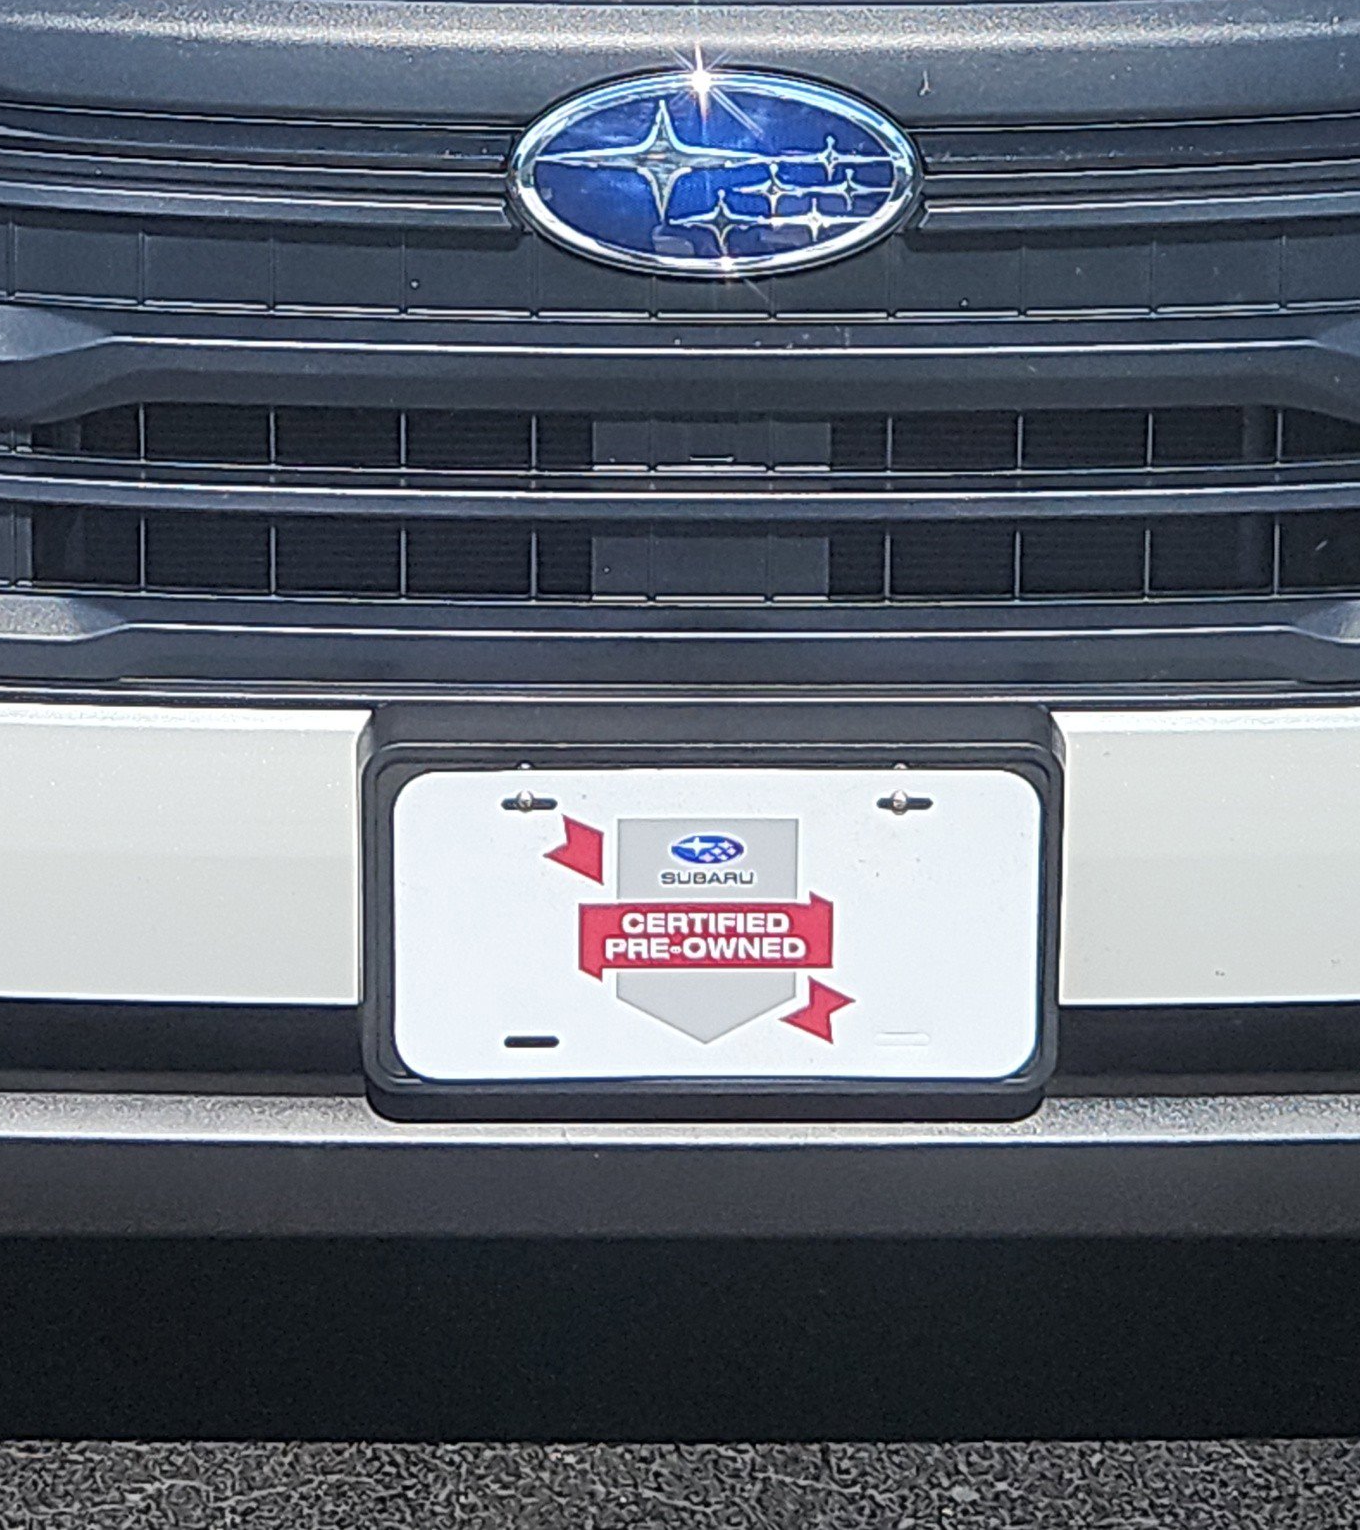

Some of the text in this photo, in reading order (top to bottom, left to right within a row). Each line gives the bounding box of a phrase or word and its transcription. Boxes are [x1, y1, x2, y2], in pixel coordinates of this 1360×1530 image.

[660, 871, 755, 886] SUBARU
[622, 912, 791, 936] CERTIFIED
[604, 937, 807, 961] PRE-OWNED
